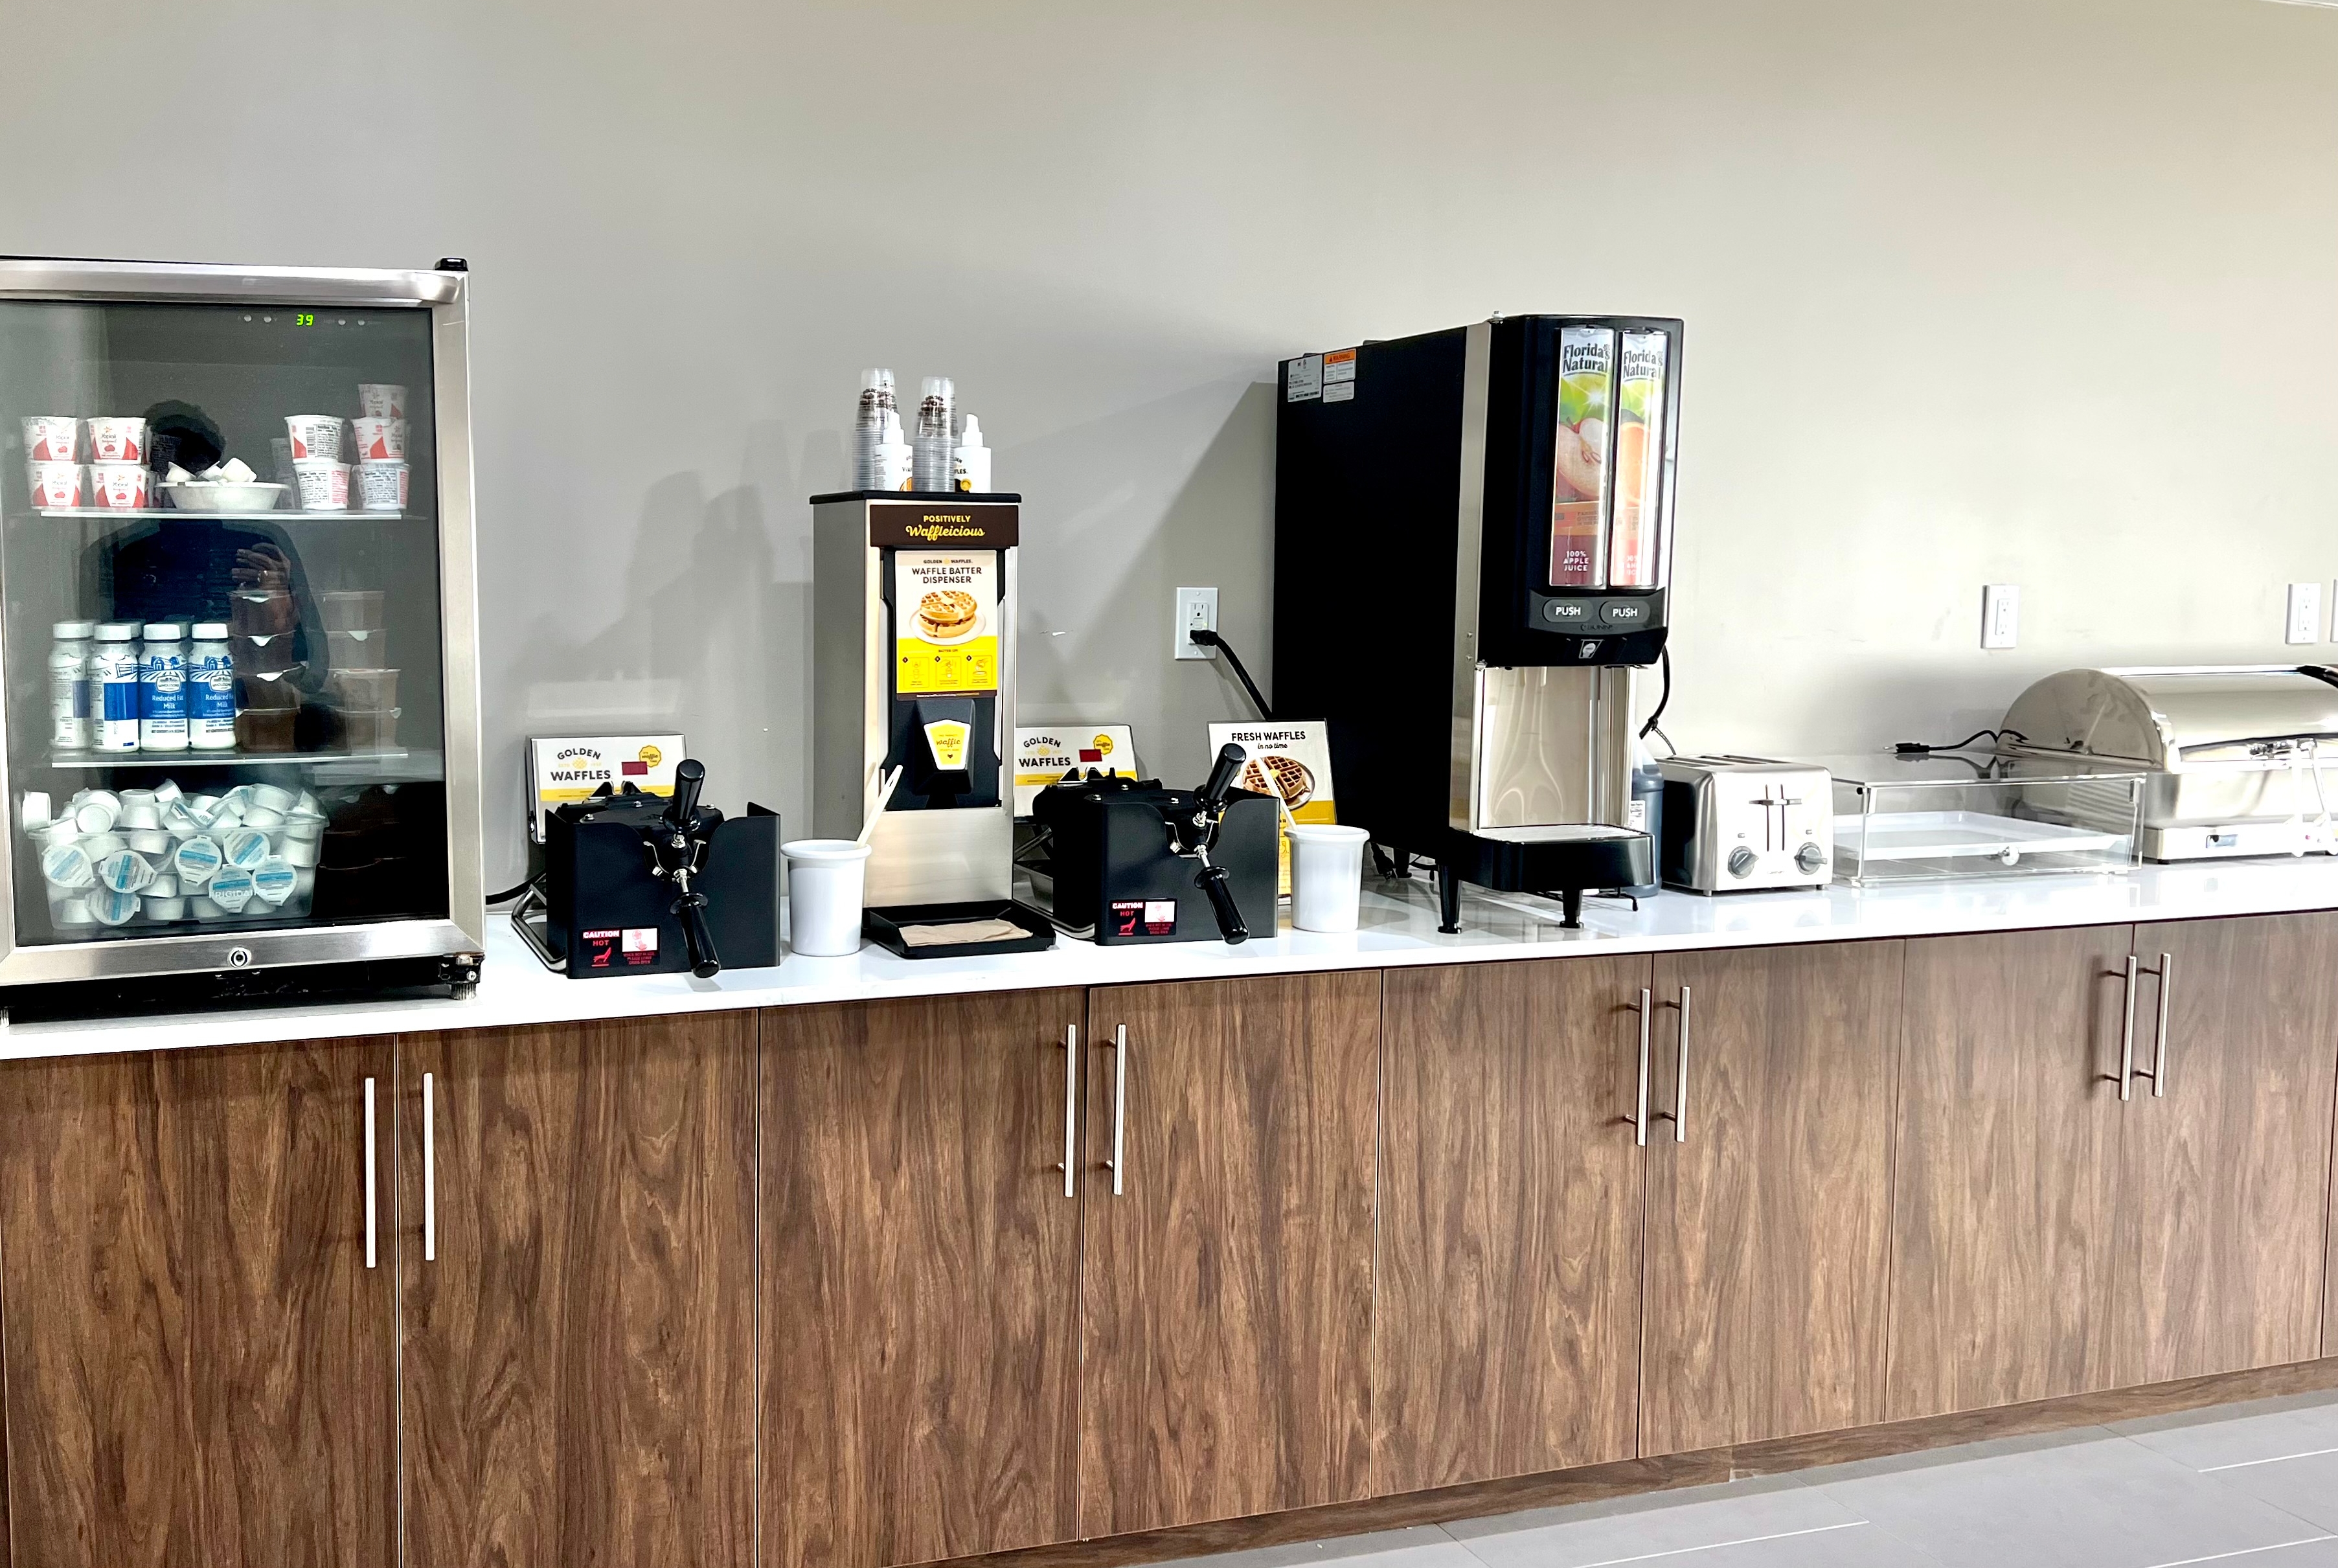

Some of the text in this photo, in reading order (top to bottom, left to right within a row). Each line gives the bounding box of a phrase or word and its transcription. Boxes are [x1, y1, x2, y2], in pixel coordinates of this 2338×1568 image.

[296, 314, 313, 326] 39
[1562, 357, 1609, 374] Natural
[1623, 363, 1661, 380] Natural
[905, 524, 986, 541] Waffleicious
[923, 576, 972, 584] DISPENSER
[1556, 606, 1638, 617] PUSH PUSH
[1023, 736, 1061, 748] GOLDEN
[1231, 731, 1306, 742] FRESH WAFFLES
[557, 747, 601, 760] GOLDEN
[1019, 757, 1071, 767] WAFFLES
[550, 770, 611, 781] WAFFLES
[583, 930, 620, 938] CAUTION
